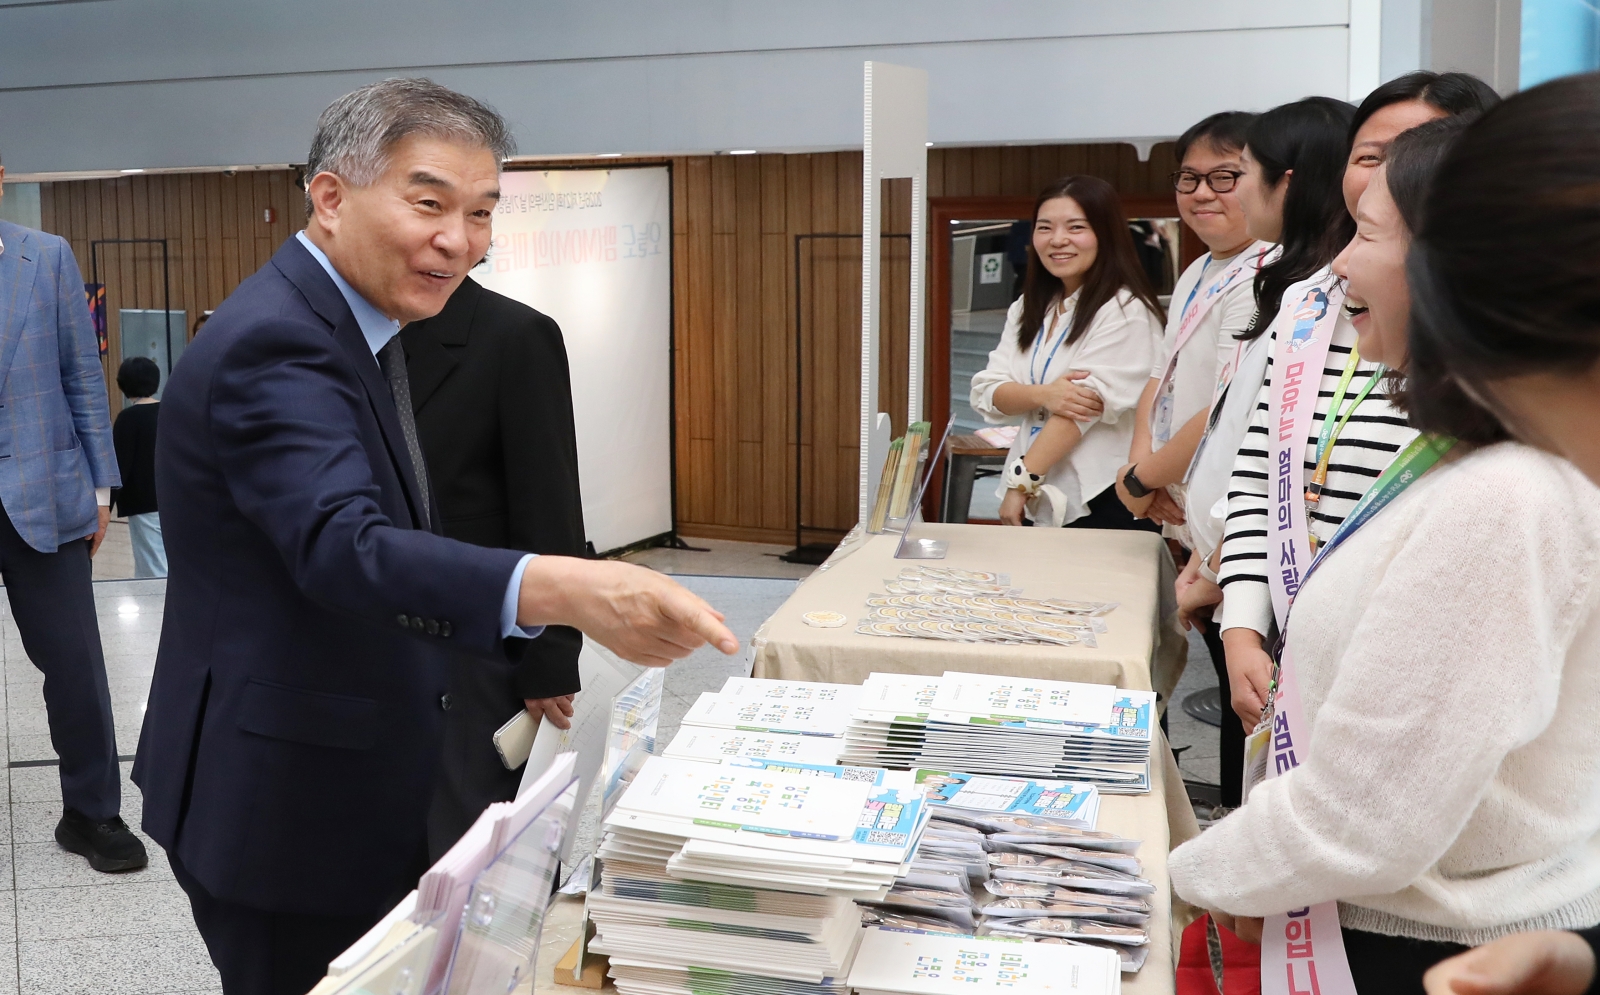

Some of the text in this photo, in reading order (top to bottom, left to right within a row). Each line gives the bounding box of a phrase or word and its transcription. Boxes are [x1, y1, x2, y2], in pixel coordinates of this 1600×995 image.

[1278, 361, 1305, 598] 모유는 엄마의 사랑
[765, 685, 788, 698] 지원센
[791, 687, 814, 701] 육아종
[697, 776, 735, 810] 지원센터
[731, 780, 774, 815] 육아종합
[778, 785, 810, 809] 강남구
[912, 956, 943, 978] 강남구
[952, 949, 990, 983] 육아종합
[996, 952, 1029, 987] 지원센터
